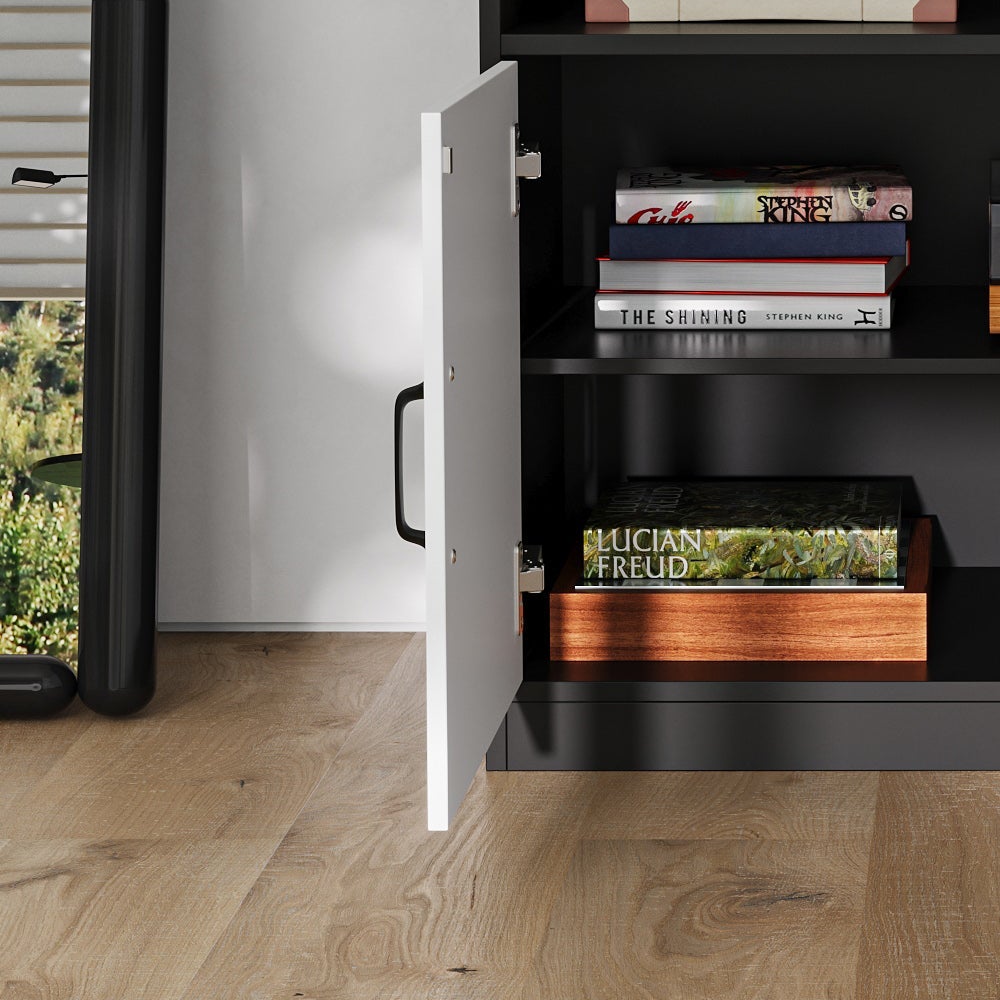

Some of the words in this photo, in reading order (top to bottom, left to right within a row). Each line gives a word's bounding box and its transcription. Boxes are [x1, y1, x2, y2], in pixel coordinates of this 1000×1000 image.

[757, 195, 833, 209] STEPHEN
[763, 207, 832, 223] KING
[620, 310, 655, 325] THE
[666, 310, 747, 325] SHINING
[597, 528, 701, 552] LUCIAN
[597, 556, 688, 579] FREUD
